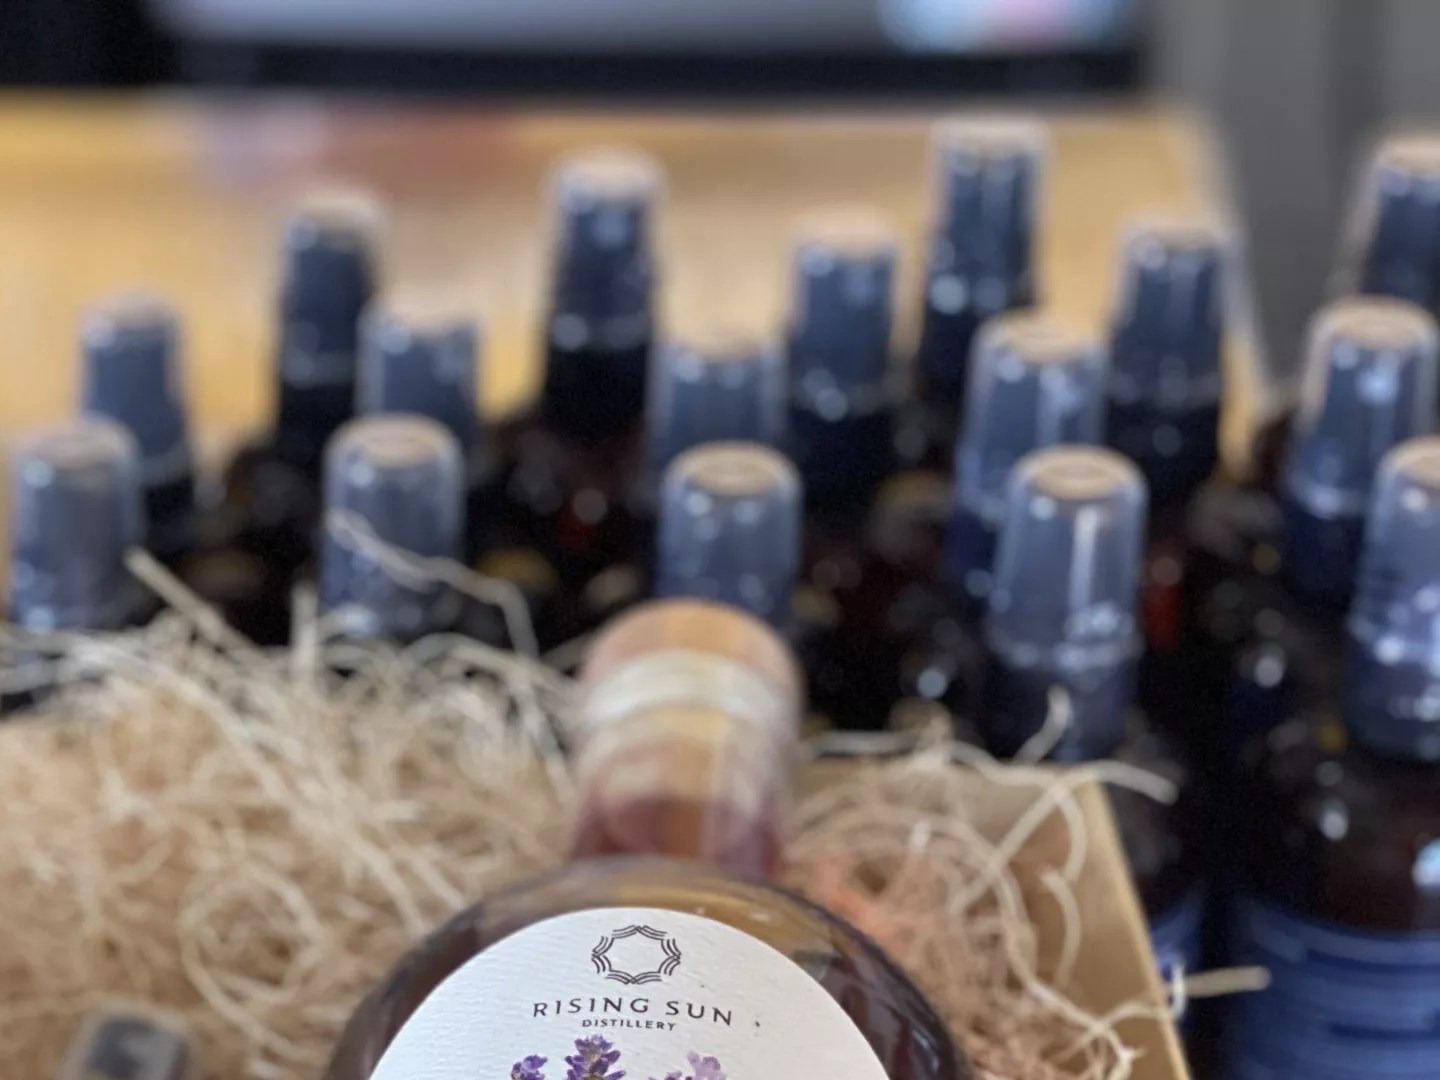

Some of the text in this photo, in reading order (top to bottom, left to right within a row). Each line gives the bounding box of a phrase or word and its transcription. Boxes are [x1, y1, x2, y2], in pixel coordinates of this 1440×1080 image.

[533, 997, 732, 1026] RISING SUN
[581, 1018, 677, 1031] DISTILLERY
